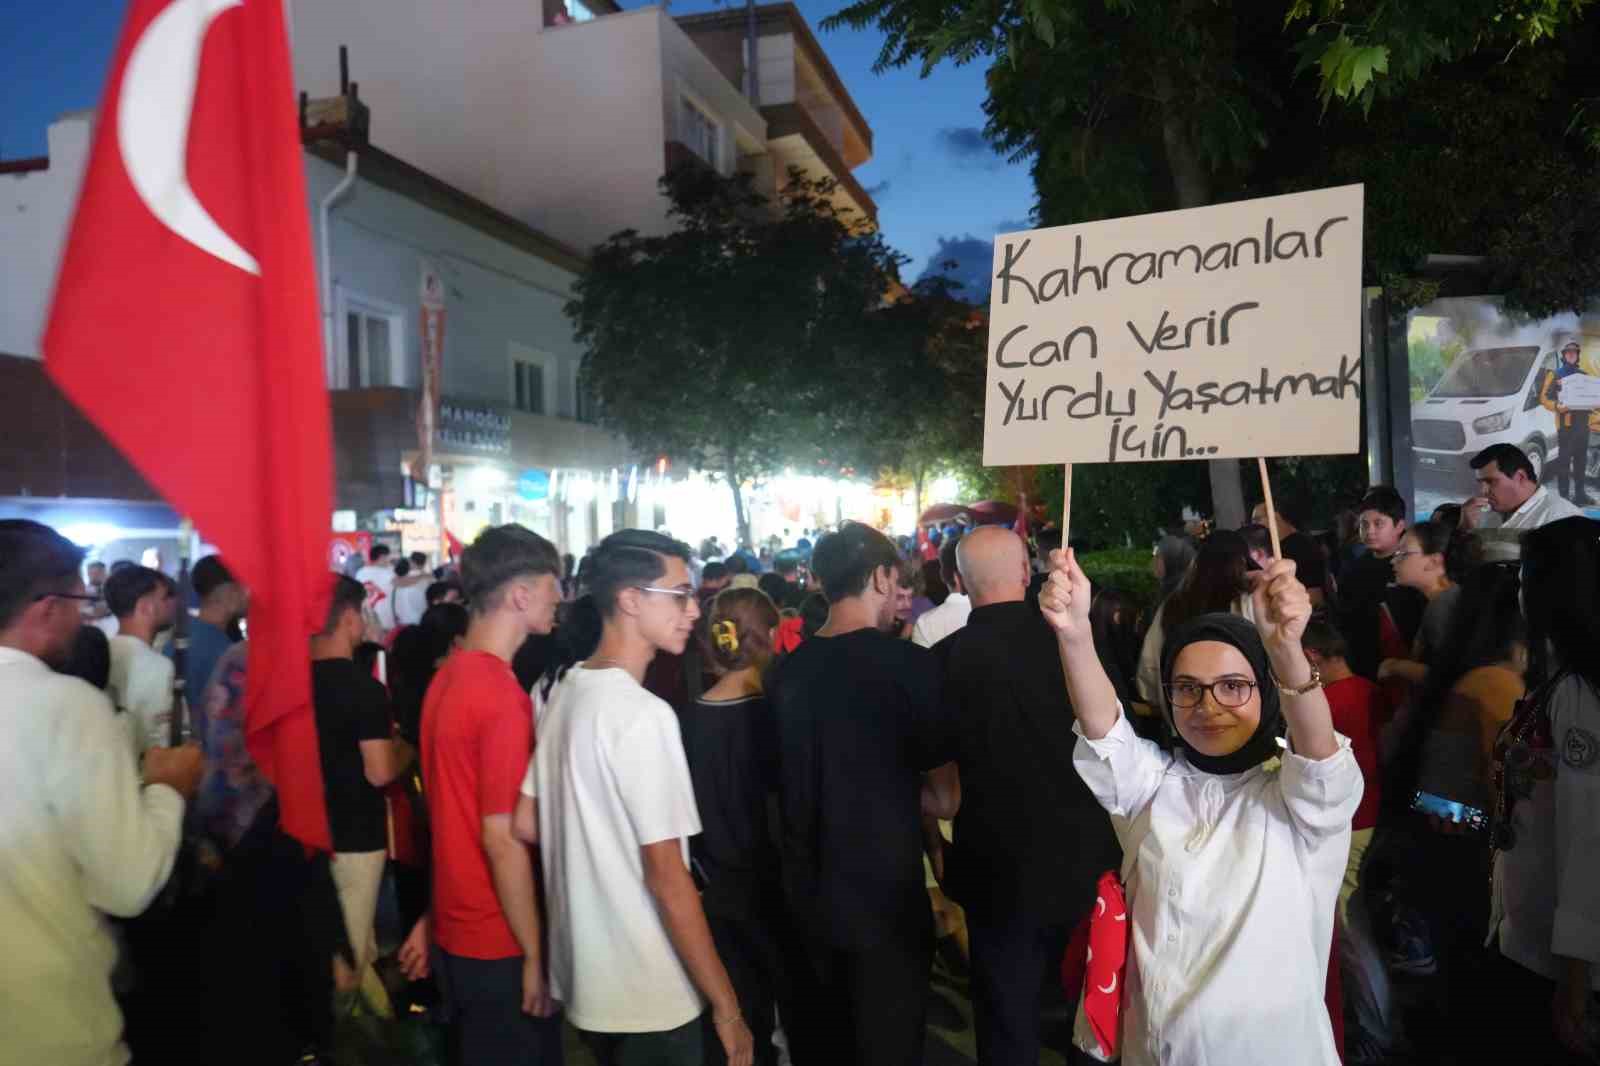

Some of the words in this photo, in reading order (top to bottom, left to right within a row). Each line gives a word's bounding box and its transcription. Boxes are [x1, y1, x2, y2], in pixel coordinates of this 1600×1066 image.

[996, 217, 1348, 304] Kahramanlar
[995, 324, 1098, 369] Can
[1126, 301, 1259, 354] Verir
[998, 371, 1137, 426] Yurdu
[1143, 355, 1361, 420] Yaşatmak
